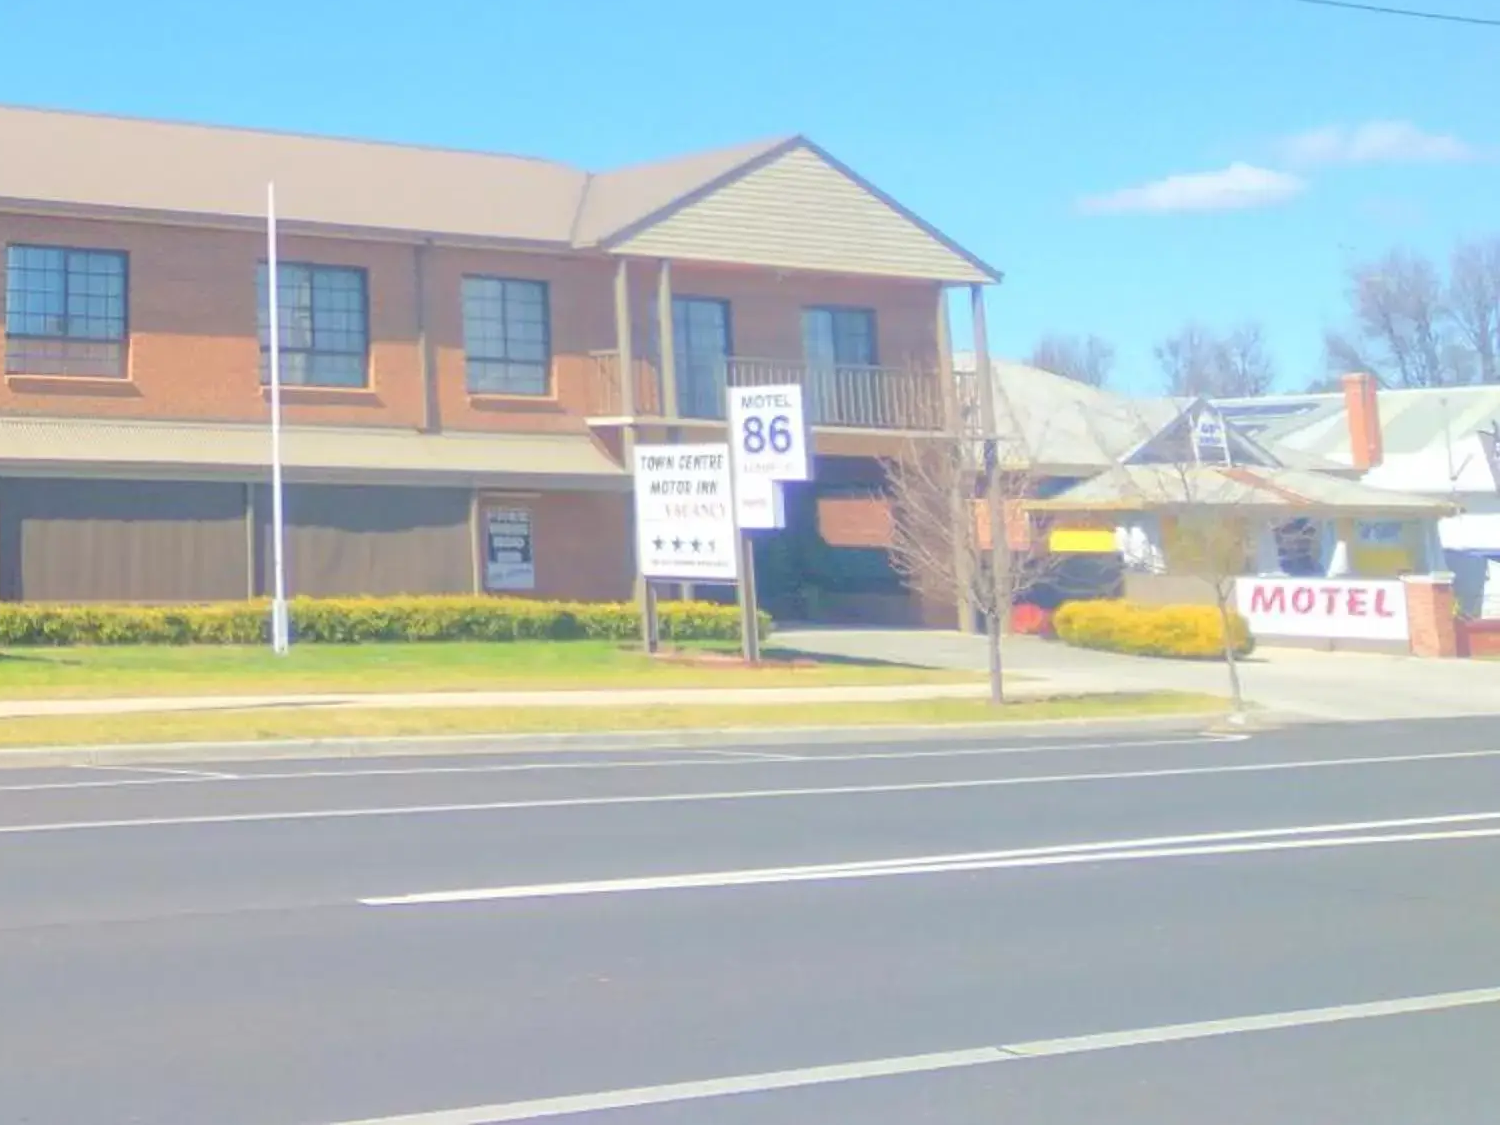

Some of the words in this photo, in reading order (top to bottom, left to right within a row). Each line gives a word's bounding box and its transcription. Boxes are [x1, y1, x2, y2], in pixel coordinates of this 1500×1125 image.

[741, 393, 792, 409] MOTEL
[743, 414, 792, 454] 86
[641, 455, 675, 471] TOWN
[679, 454, 724, 470] CENTRE
[650, 480, 692, 495] MOTOR
[696, 480, 719, 495] INN
[1251, 585, 1396, 617] MOTEL
